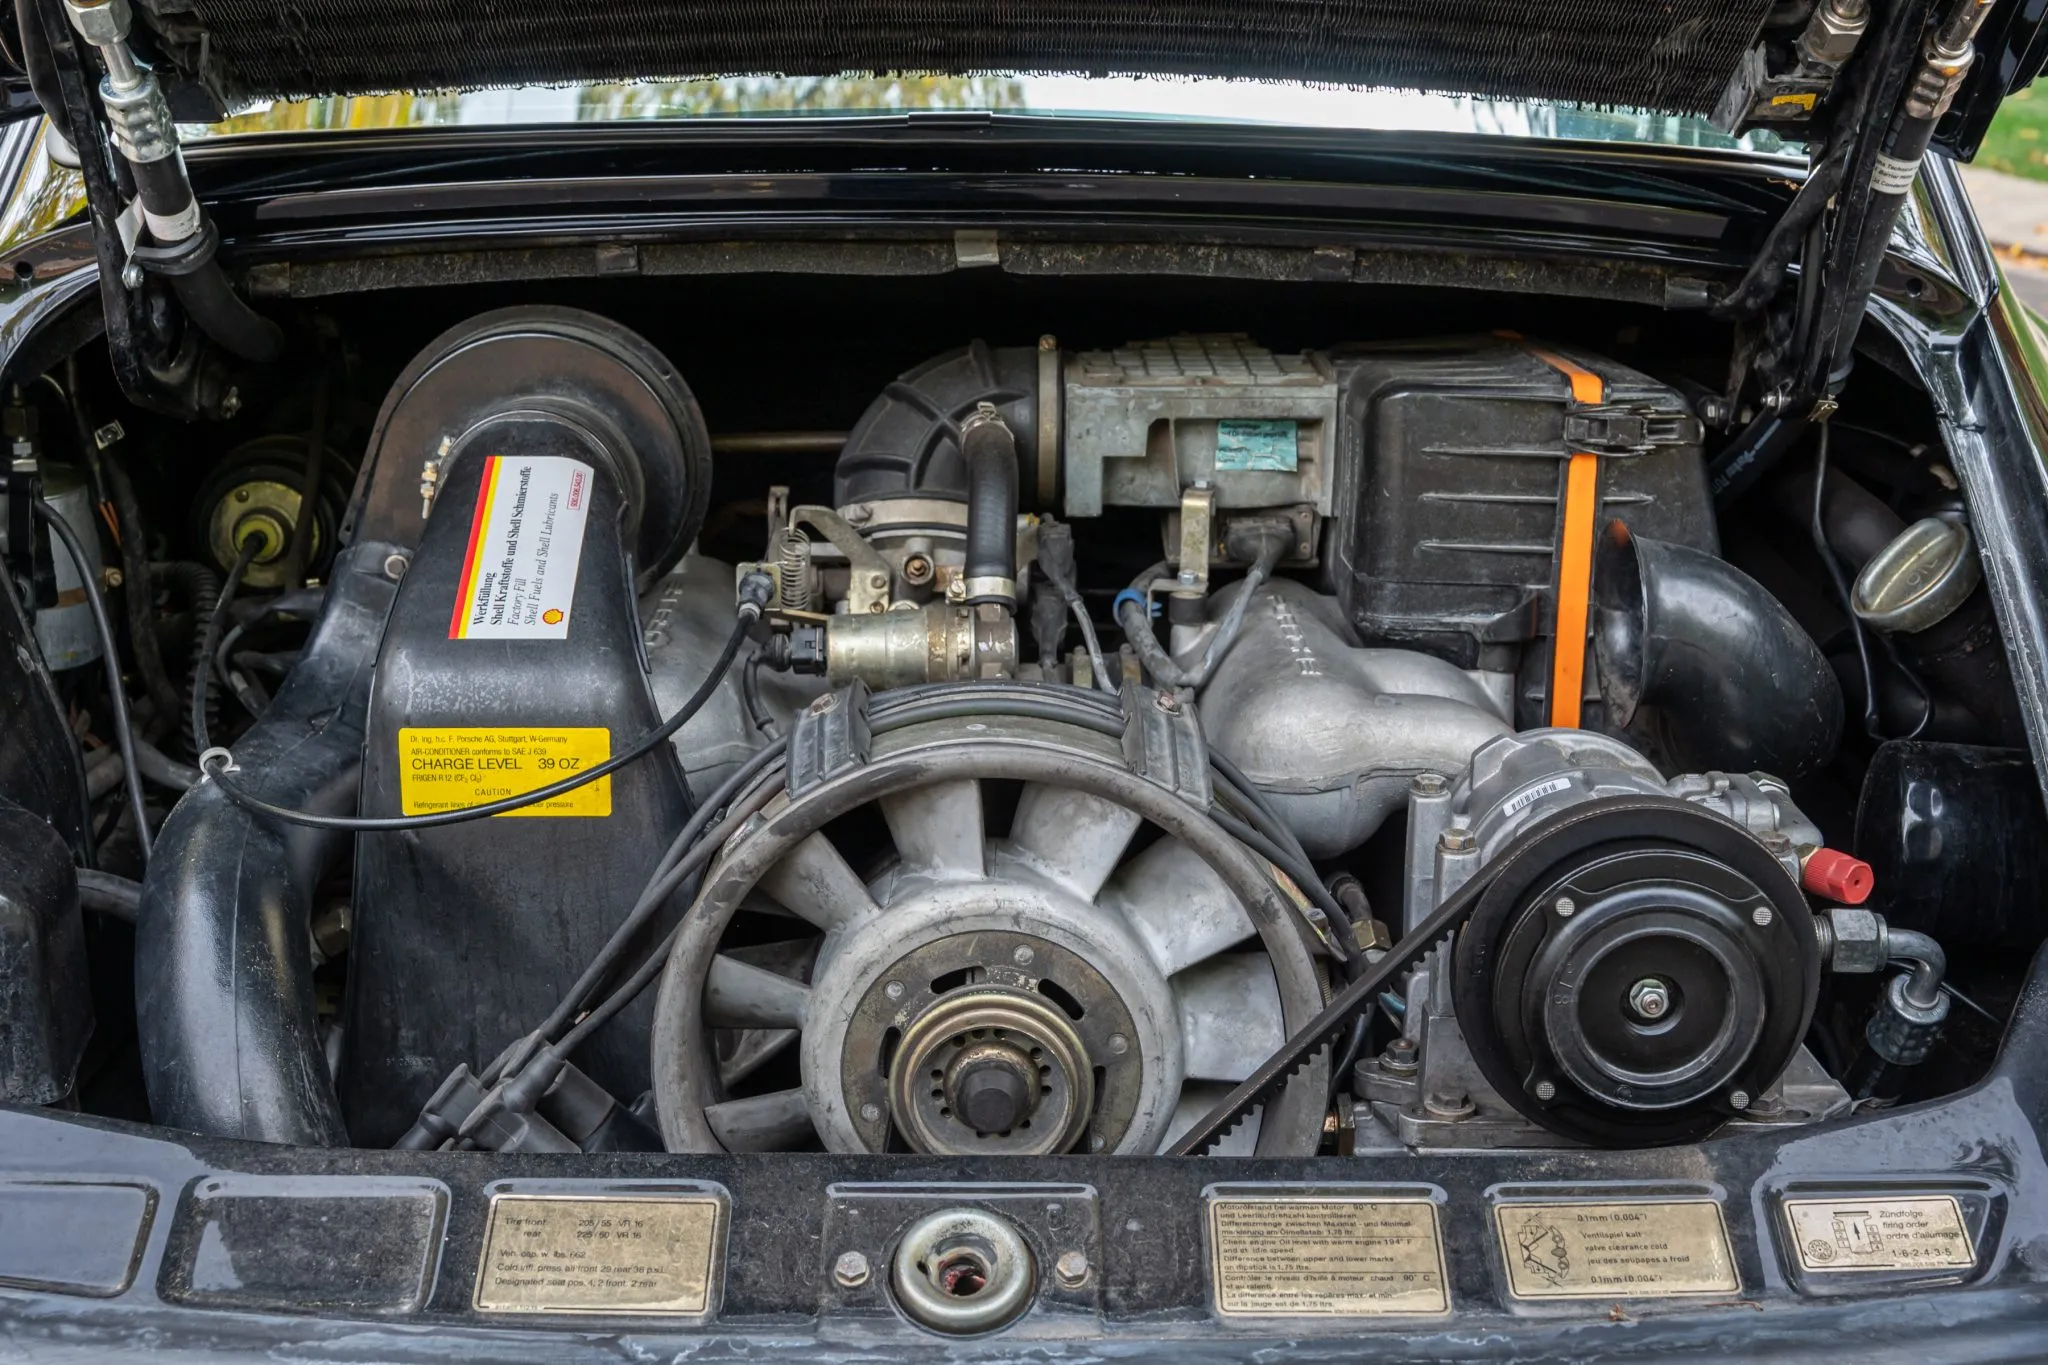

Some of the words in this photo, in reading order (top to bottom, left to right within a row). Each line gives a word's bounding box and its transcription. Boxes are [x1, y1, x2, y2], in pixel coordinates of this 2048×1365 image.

[512, 466, 532, 518] Schmierstoffe
[540, 492, 558, 536] Lubricants
[507, 520, 522, 539] Shell
[506, 540, 518, 556] und
[536, 538, 551, 558] Shell
[536, 560, 547, 576] and
[494, 558, 514, 602] Kraftstoffe
[514, 578, 526, 592] Fill
[528, 578, 544, 602] Fuels
[473, 572, 497, 625] Werkfüllung
[490, 604, 504, 625] Shell
[508, 594, 524, 626] Factory
[524, 604, 540, 626] Shell
[530, 736, 568, 744] W-Germany
[412, 758, 474, 770] CHARGE
[478, 758, 522, 770] LEVEL
[538, 758, 555, 770] 39
[559, 758, 580, 770] OZ
[474, 788, 512, 796] CAUTION
[414, 801, 448, 810] Refrigerant
[1880, 1210, 1923, 1218] Zündfolge
[1883, 1221, 1904, 1229] firing
[1912, 1230, 1960, 1240] d'allumage
[1670, 1255, 1690, 1263] froid
